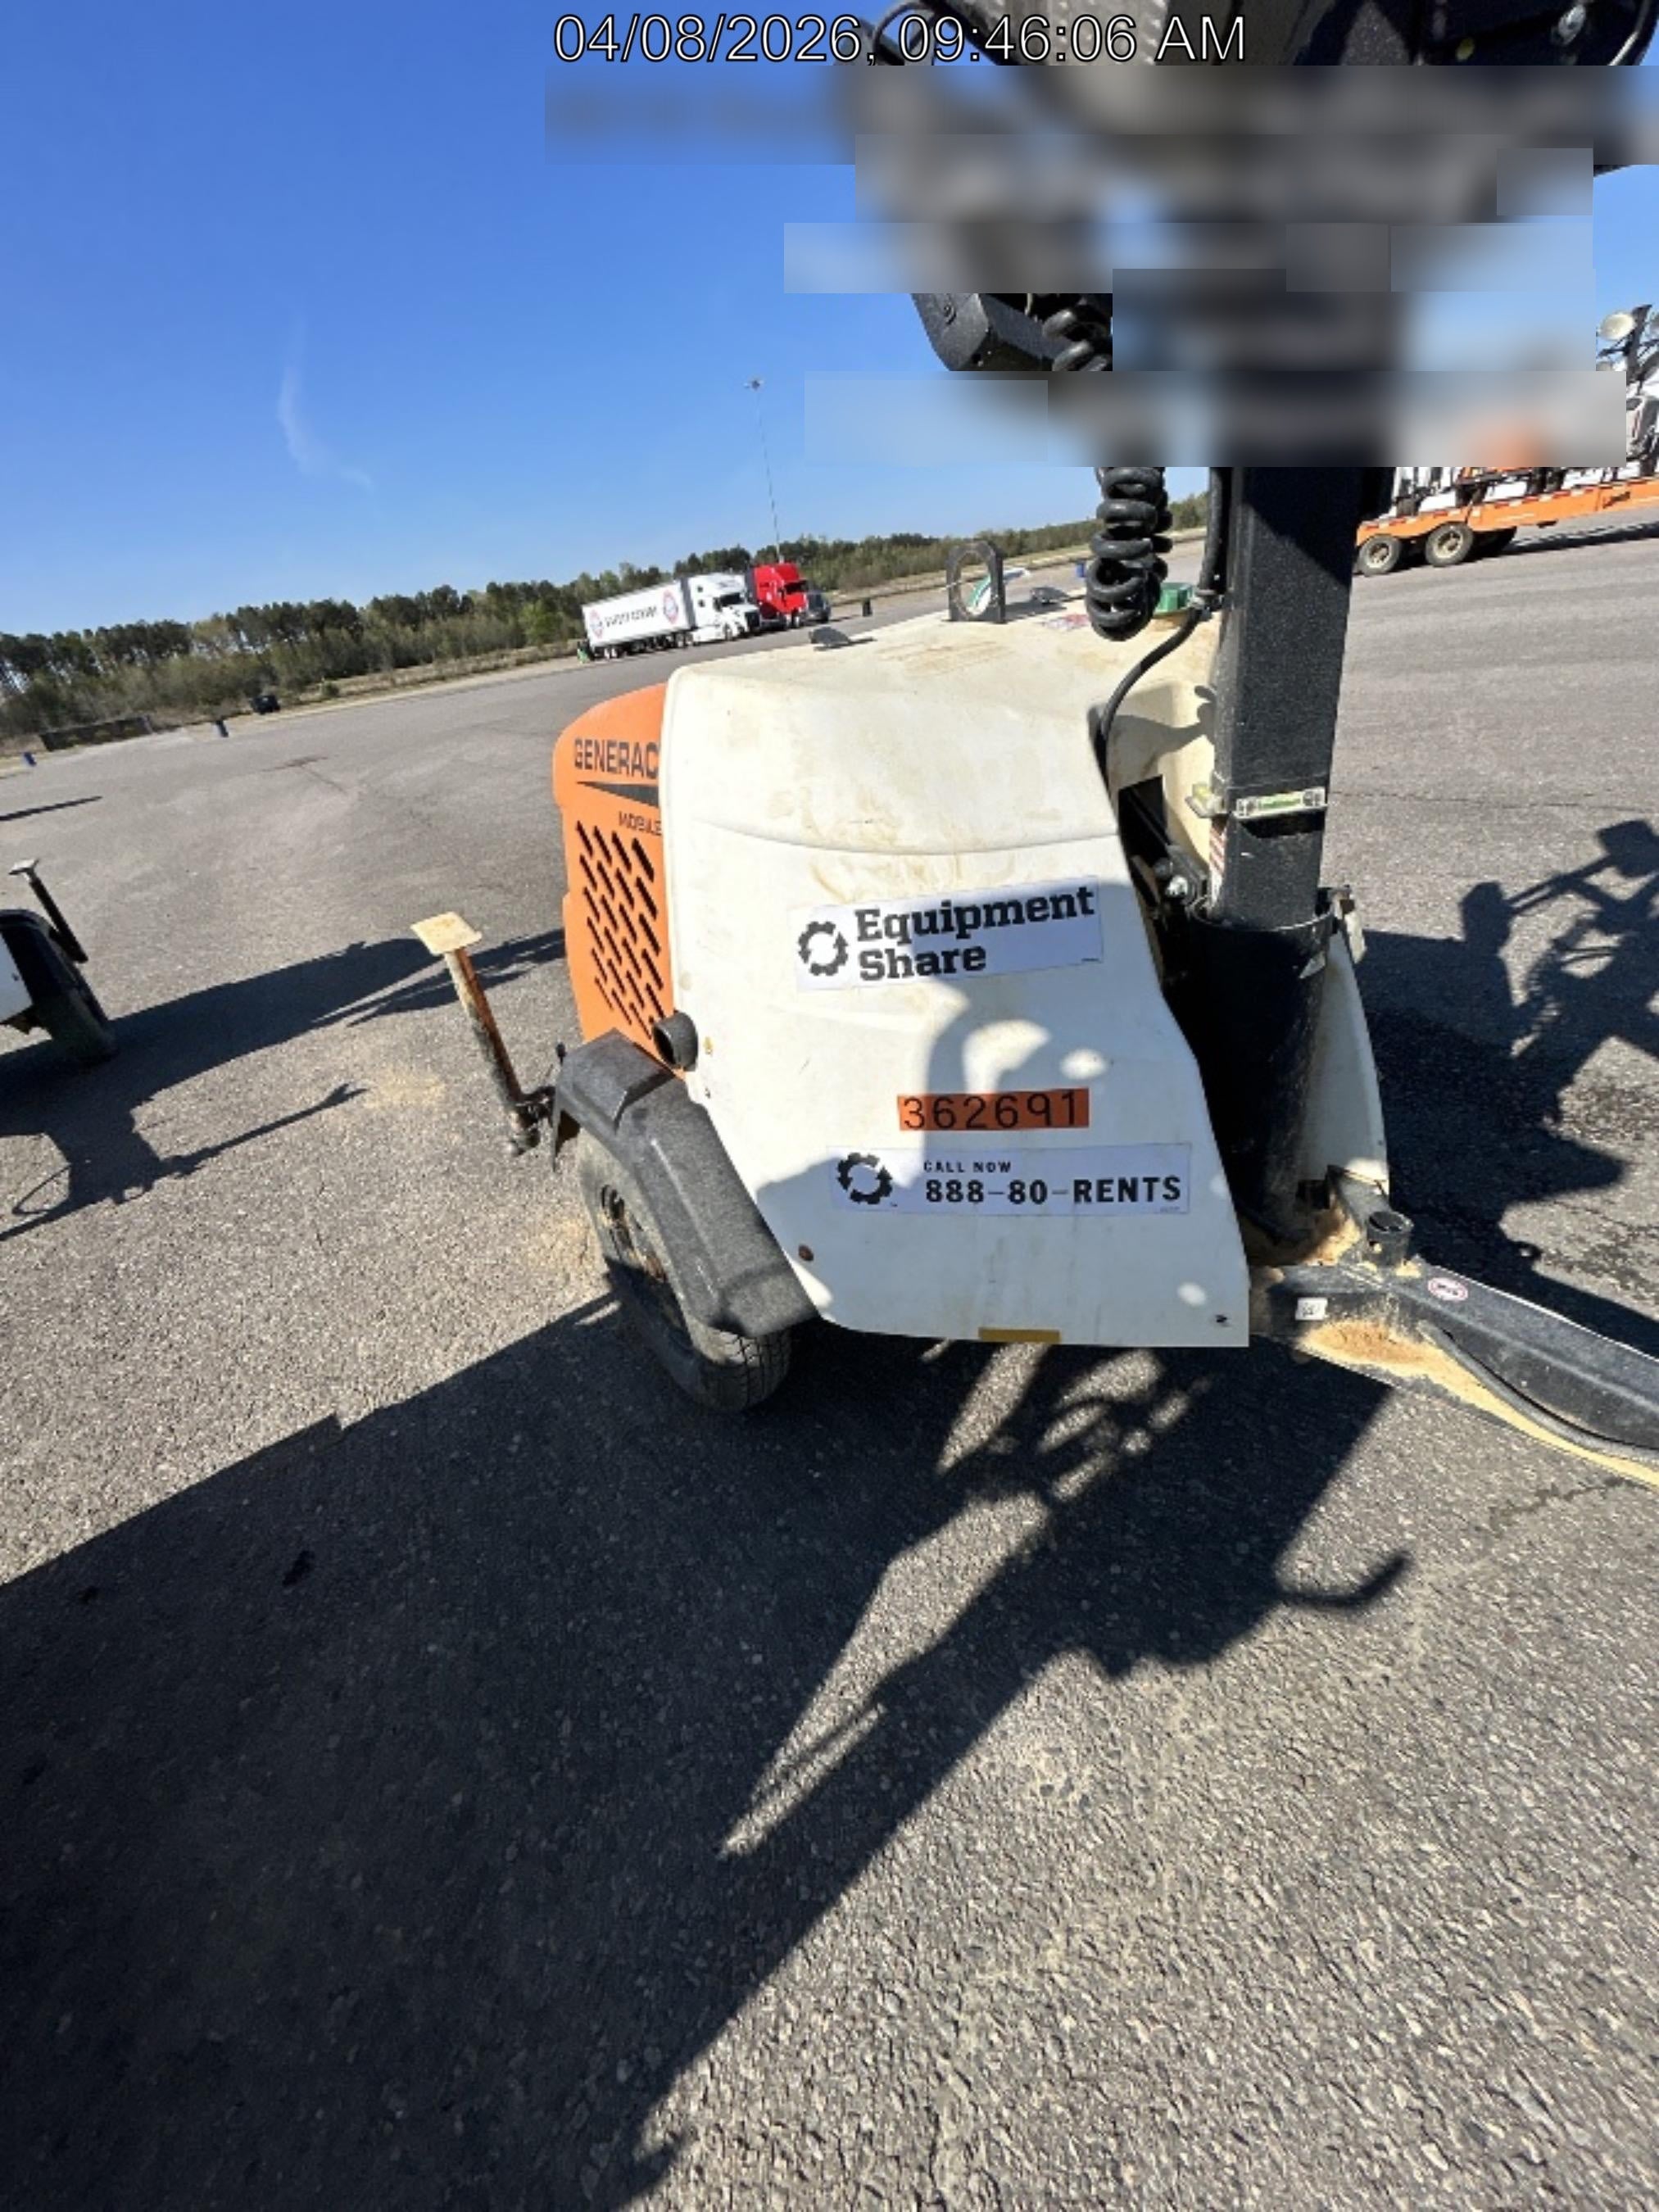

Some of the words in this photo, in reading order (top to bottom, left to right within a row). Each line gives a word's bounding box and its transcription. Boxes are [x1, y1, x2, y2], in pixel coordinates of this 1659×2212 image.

[574, 738, 659, 780] GENERAC
[854, 886, 1095, 945] Equipment
[859, 945, 987, 981] Share
[903, 1090, 1077, 1130] 362691
[923, 1160, 965, 1173] CALL
[972, 1160, 1013, 1173] NOW
[926, 1175, 1182, 1205] 888-80-RENTS
